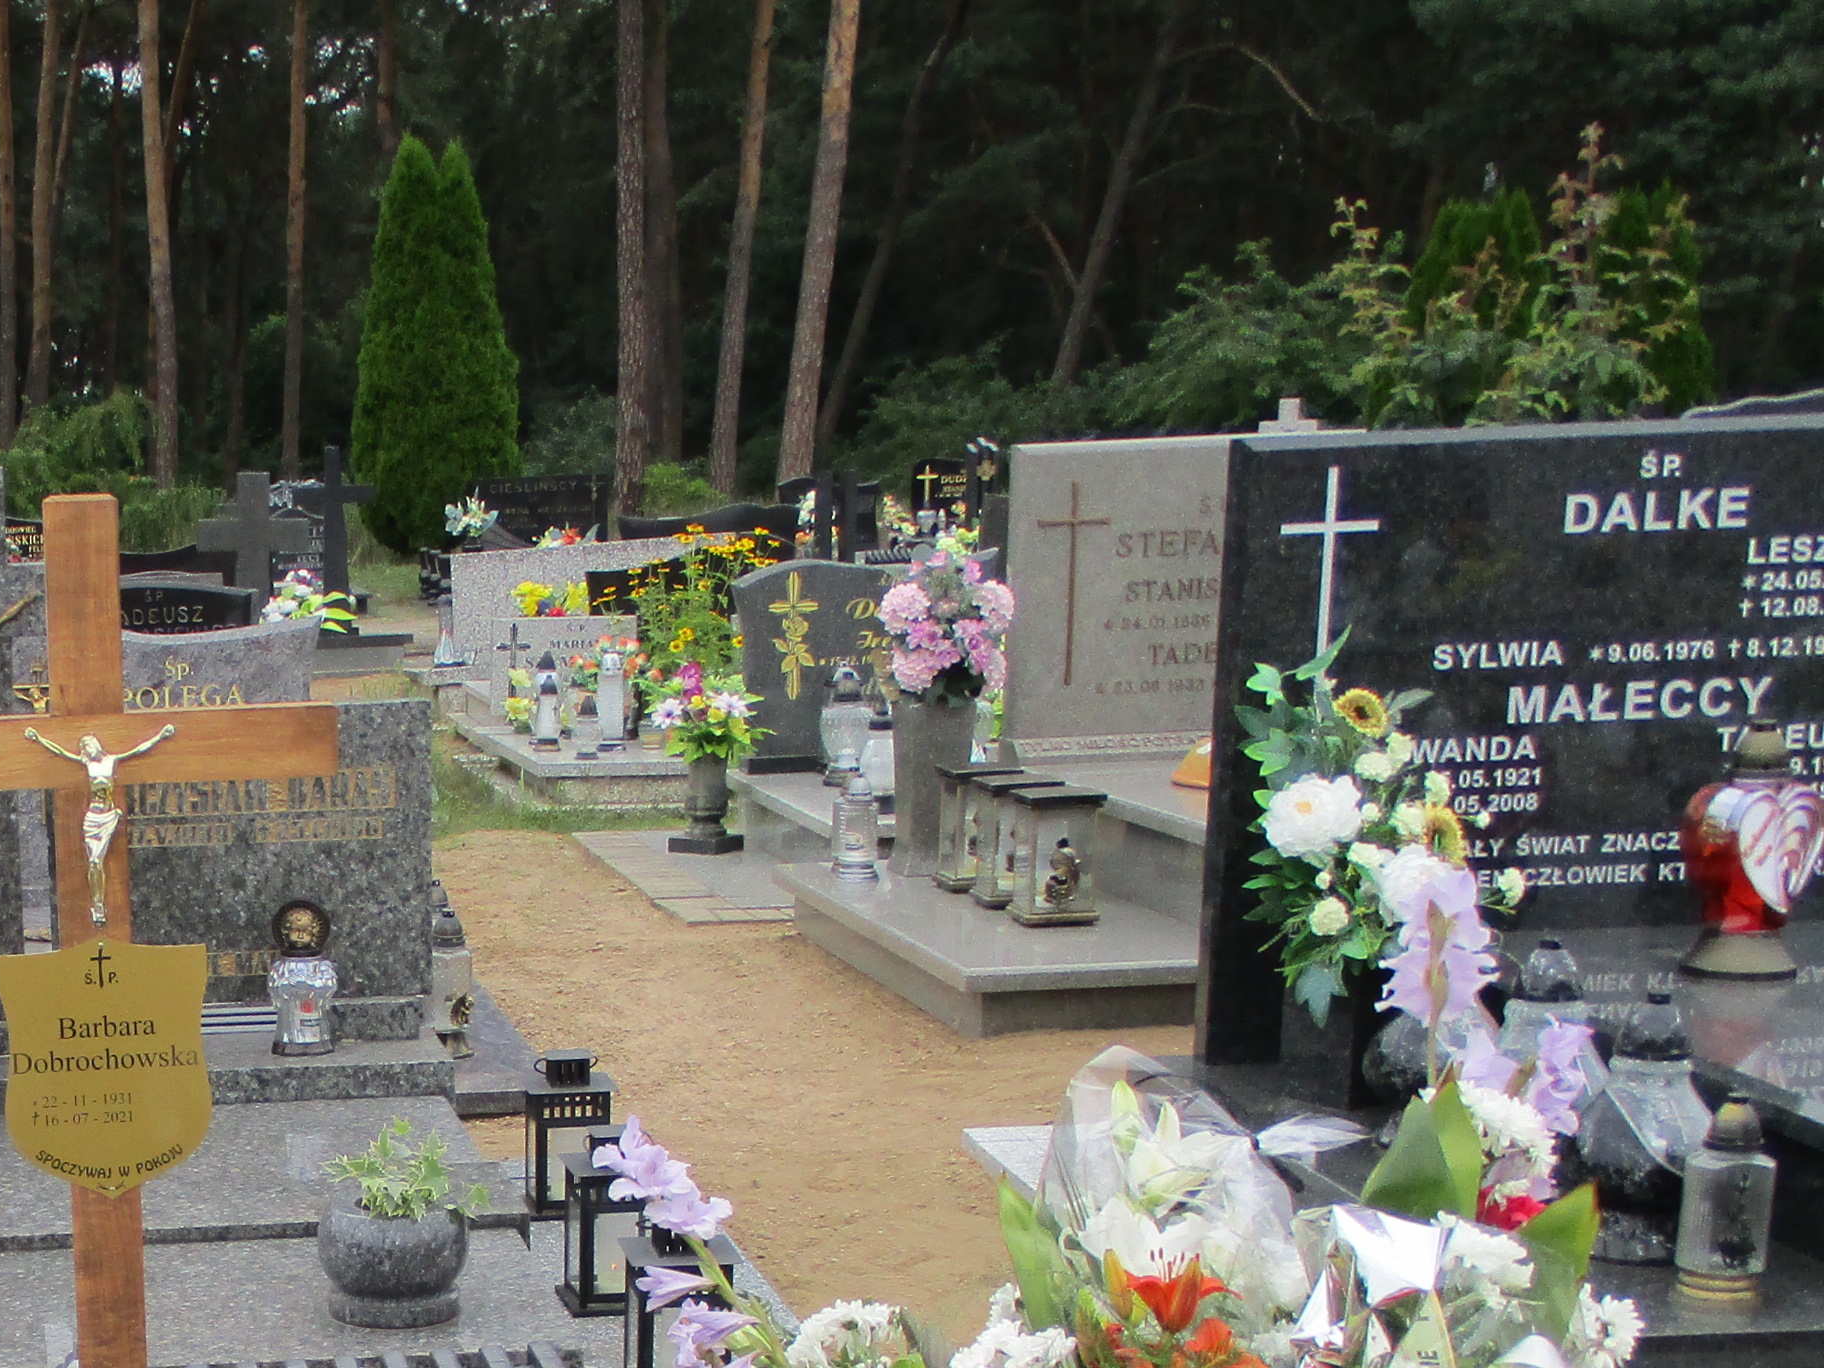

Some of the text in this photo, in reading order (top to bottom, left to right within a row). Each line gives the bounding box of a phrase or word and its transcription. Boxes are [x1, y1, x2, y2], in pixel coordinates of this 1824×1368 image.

[1563, 485, 1751, 534] DALKE
[1116, 528, 1221, 559] STEFA
[1747, 535, 1824, 565] LESZ
[1125, 577, 1219, 603] STANIS
[1761, 571, 1824, 592] 24.05.
[120, 605, 204, 626] ADEUSZ
[1761, 596, 1824, 618] 12.08.
[1147, 642, 1218, 667] TADE
[1432, 634, 1824, 672] SYLWIA 9.06.1976 8.12.19
[1505, 676, 1774, 725] MAŁECCY
[1411, 734, 1537, 763] WANDA
[1515, 832, 1591, 856] ŚWIAT
[1600, 832, 1682, 854] ZNACZ
[1523, 864, 1647, 887] CZŁOWIEK
[1658, 865, 1686, 882] KT
[57, 1014, 156, 1040] Barbara
[11, 1044, 200, 1075] Dobrochowska
[35, 1149, 113, 1180] SPOCZYWAJ
[136, 1142, 184, 1175] POKOJU
